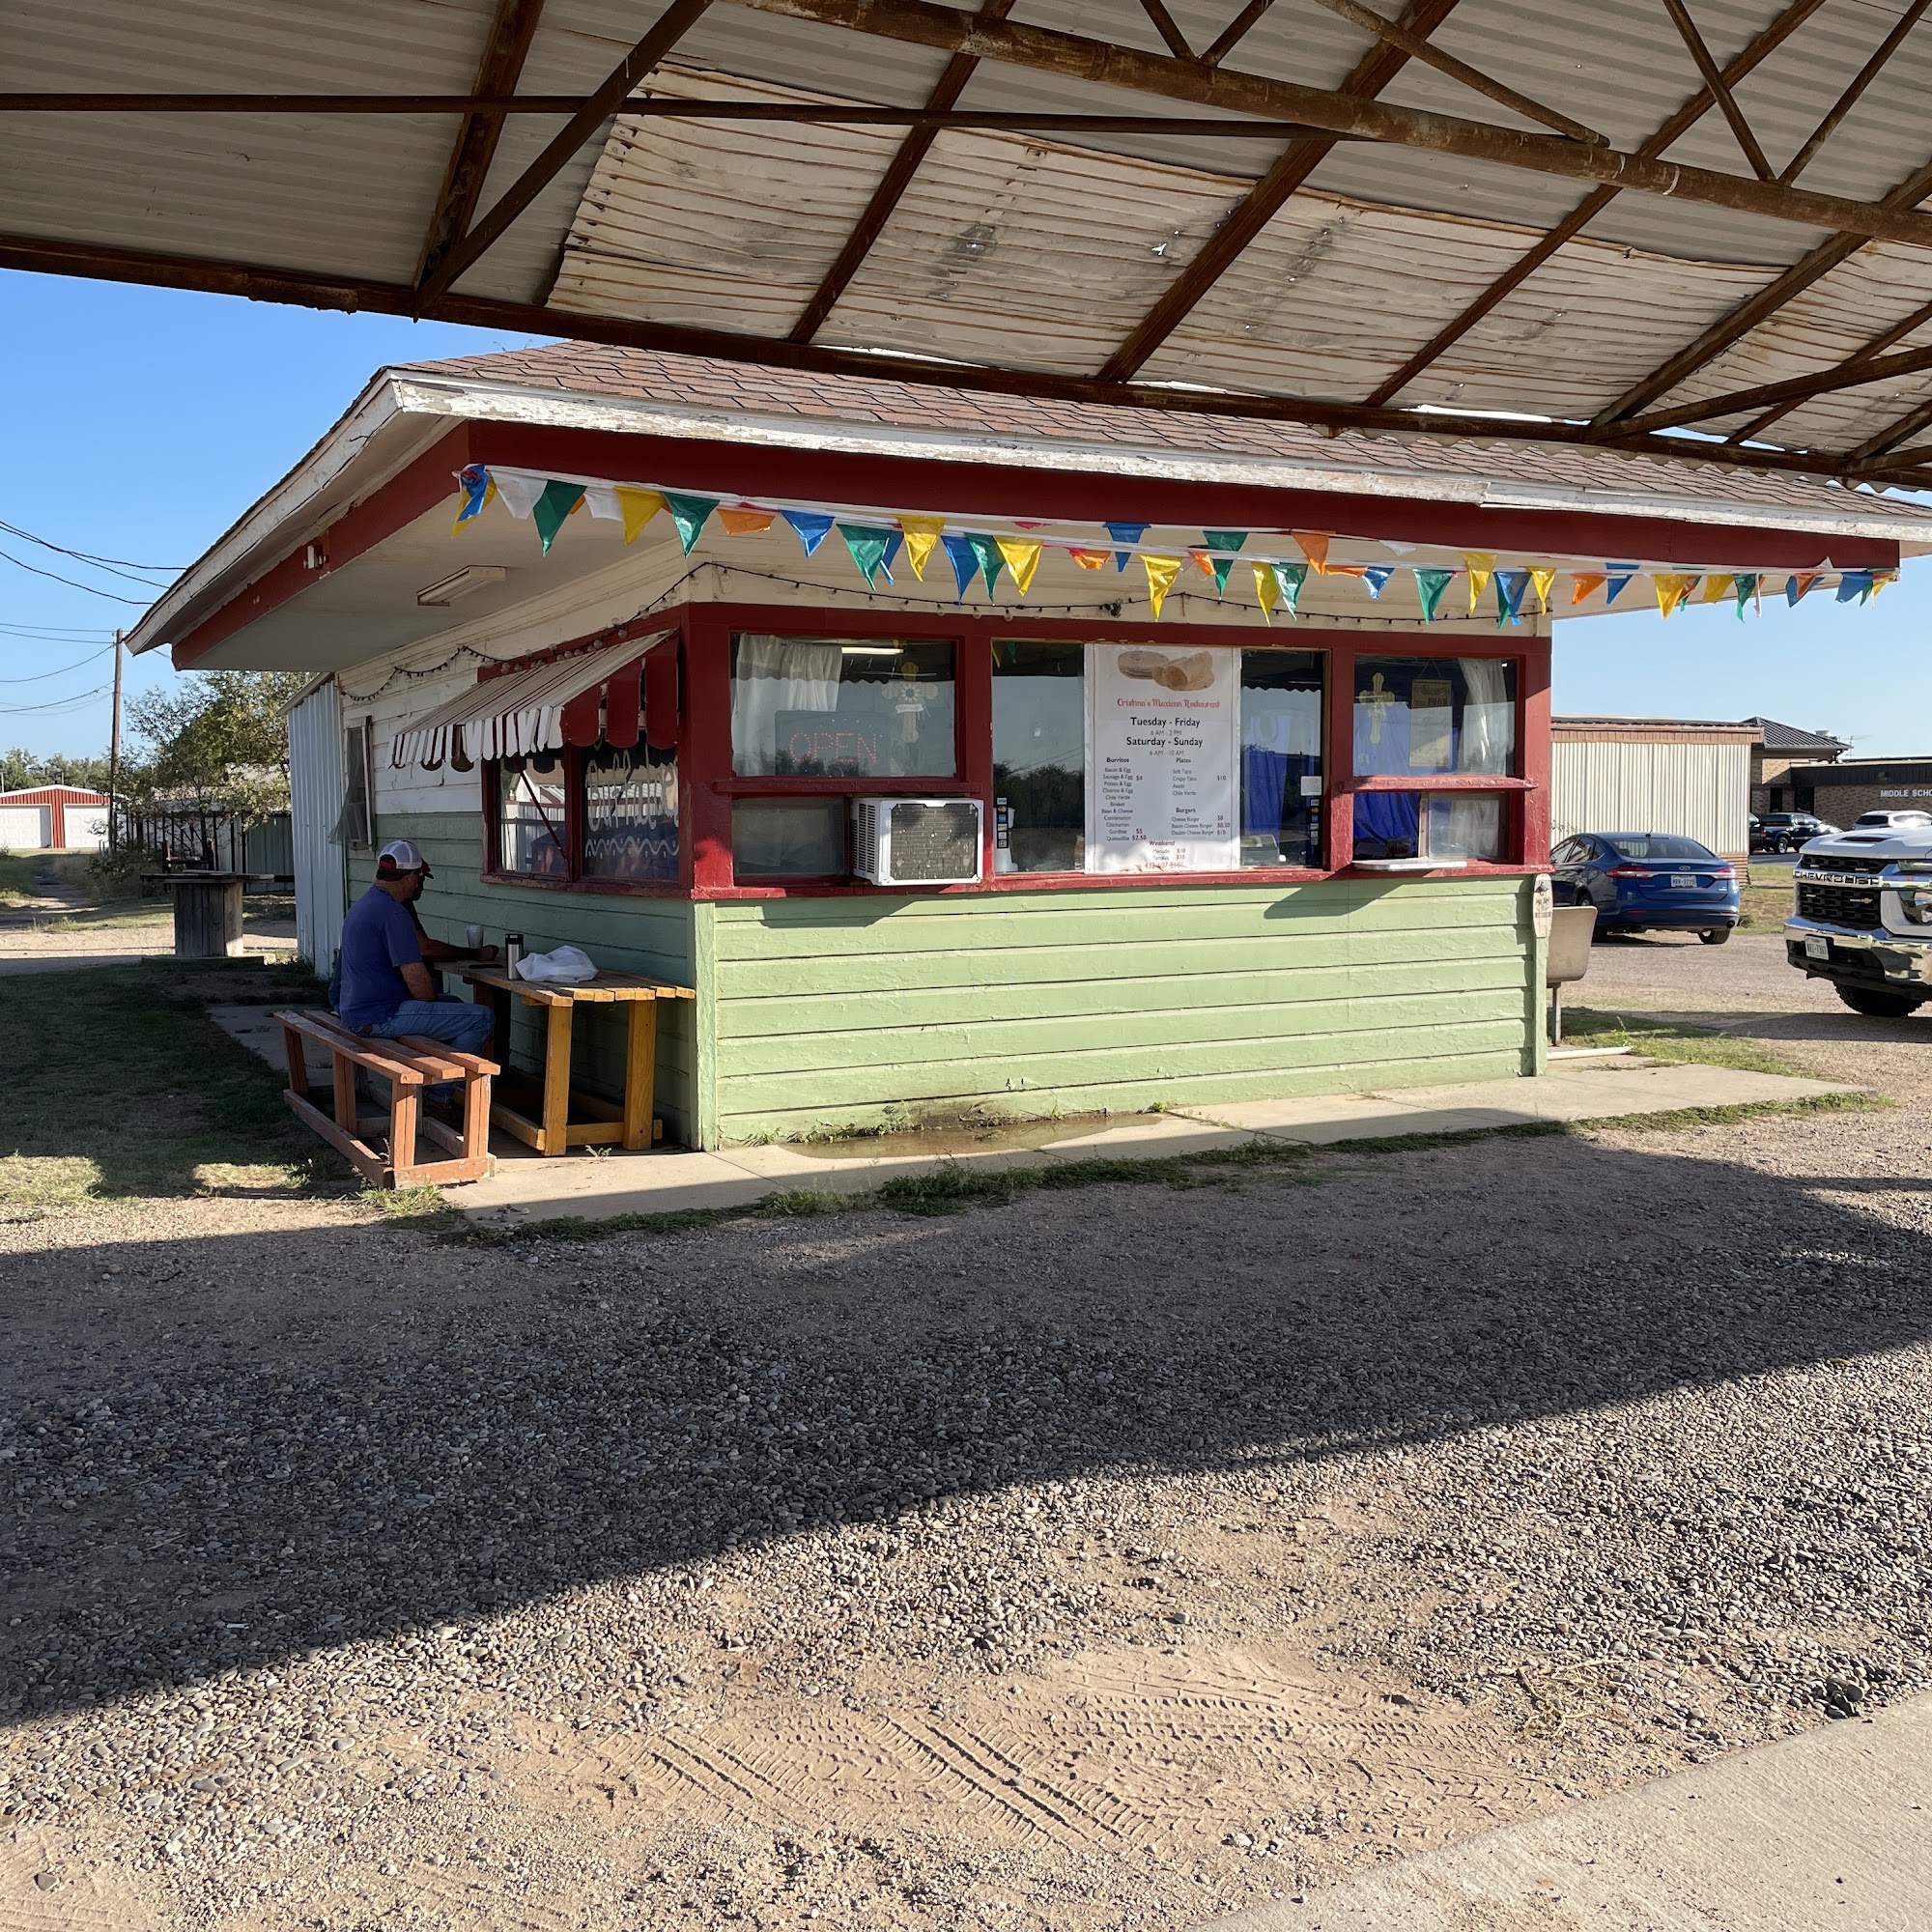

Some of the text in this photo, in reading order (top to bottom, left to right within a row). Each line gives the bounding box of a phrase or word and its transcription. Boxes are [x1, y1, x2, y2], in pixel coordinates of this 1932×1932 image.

[1117, 698, 1220, 708] Cristina's Mexican Restaurant
[1130, 717, 1167, 728] Tuesday
[1175, 718, 1201, 728] Friday
[789, 732, 877, 763] OPEN
[1126, 737, 1166, 748] Saturday
[1174, 737, 1203, 748] Sunday
[1880, 789, 1909, 798] MIDDLE
[1793, 871, 1880, 886] CHEVROLET
